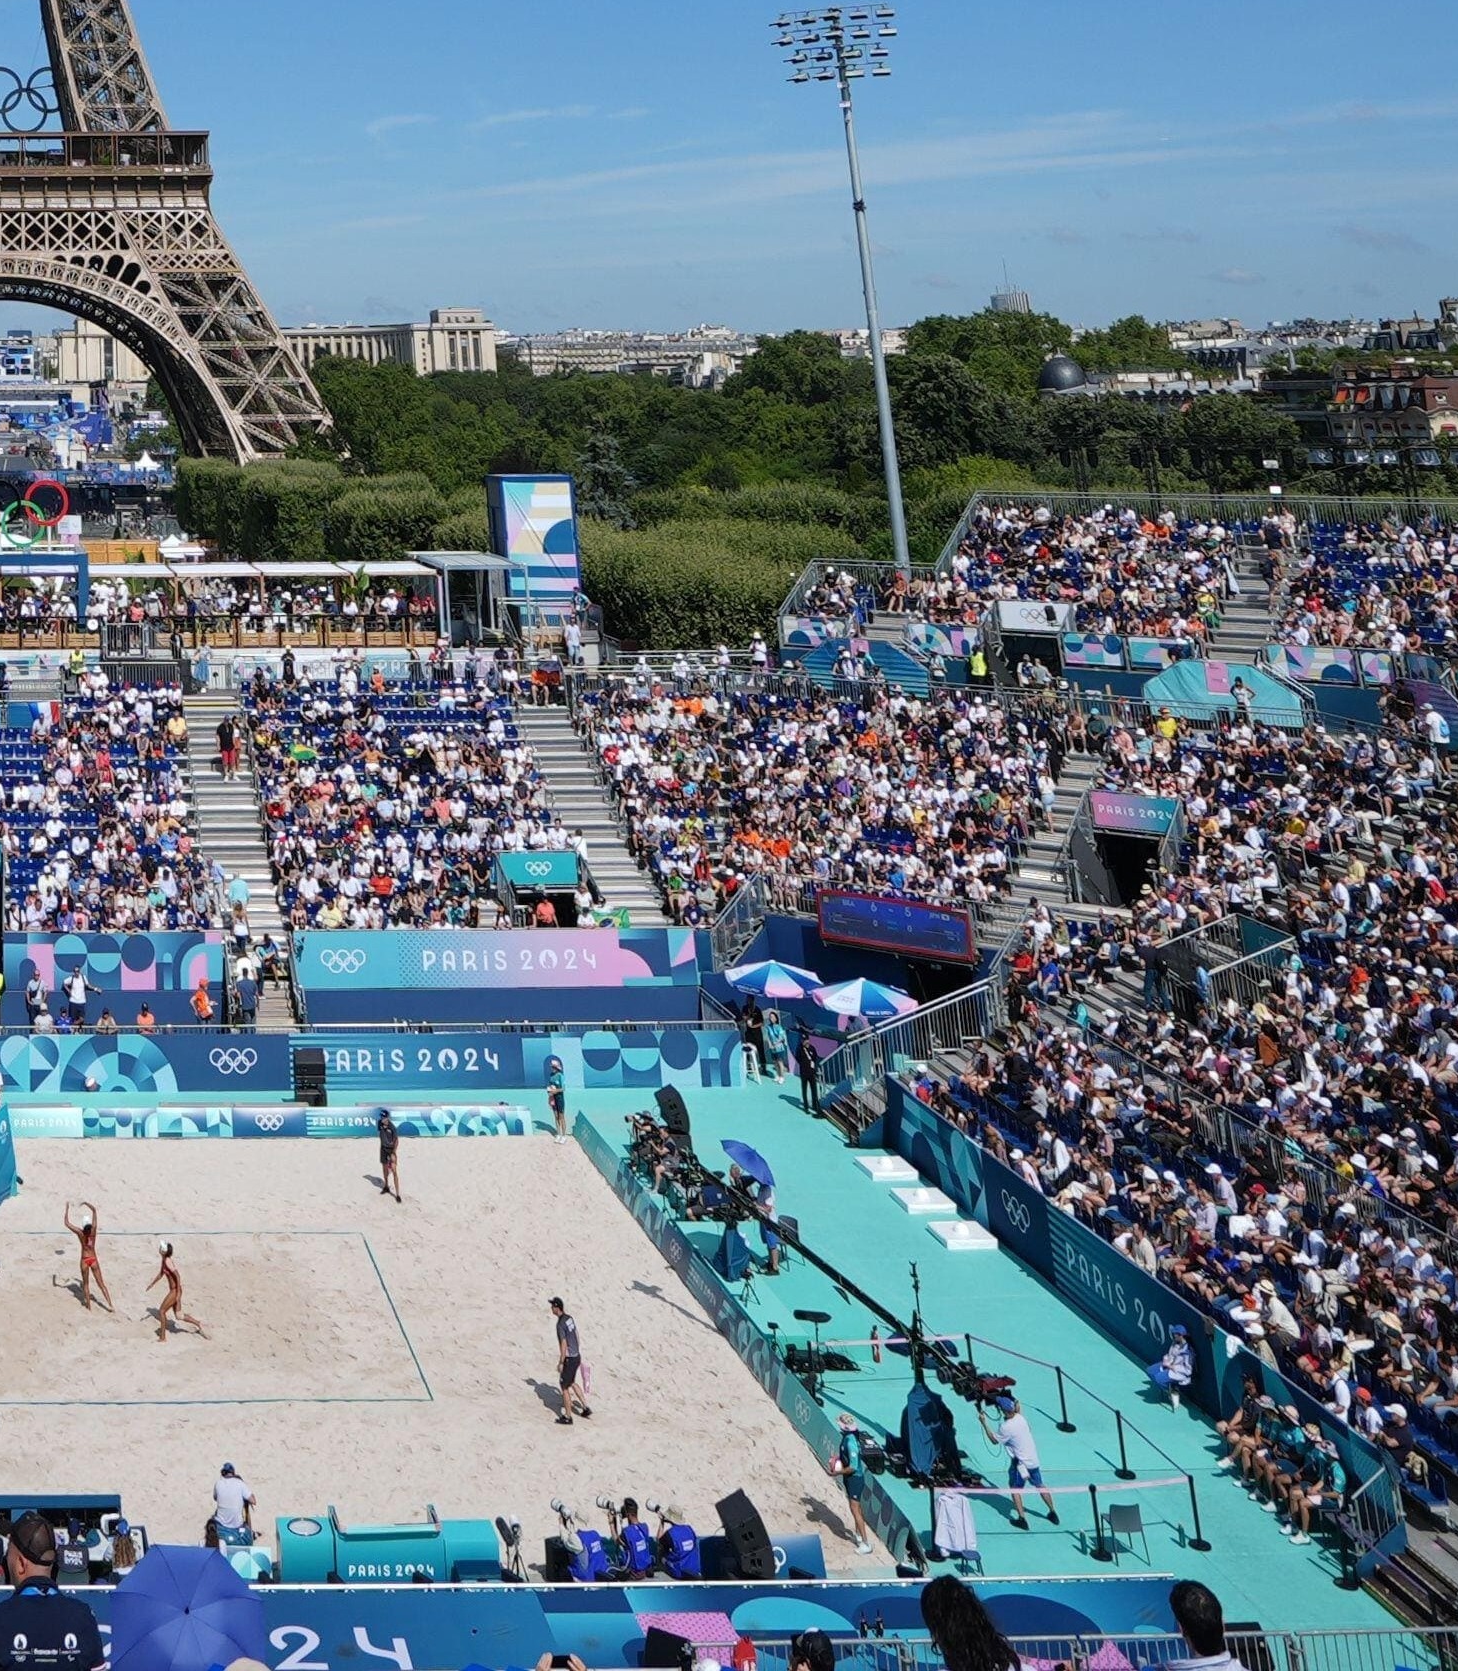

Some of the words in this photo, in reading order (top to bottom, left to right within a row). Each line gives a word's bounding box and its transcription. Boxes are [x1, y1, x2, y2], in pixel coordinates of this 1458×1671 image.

[1098, 804, 1135, 817] PARIS
[1139, 808, 1172, 821] 2024
[422, 948, 508, 971] PARIS
[520, 949, 597, 970] 2024
[417, 1048, 499, 1072] 2024
[313, 1117, 345, 1127] PARIS
[347, 1117, 377, 1128] 2024
[1065, 1241, 1126, 1316] PARIS
[1134, 1297, 1165, 1346] 20
[348, 1564, 391, 1577] PARIS
